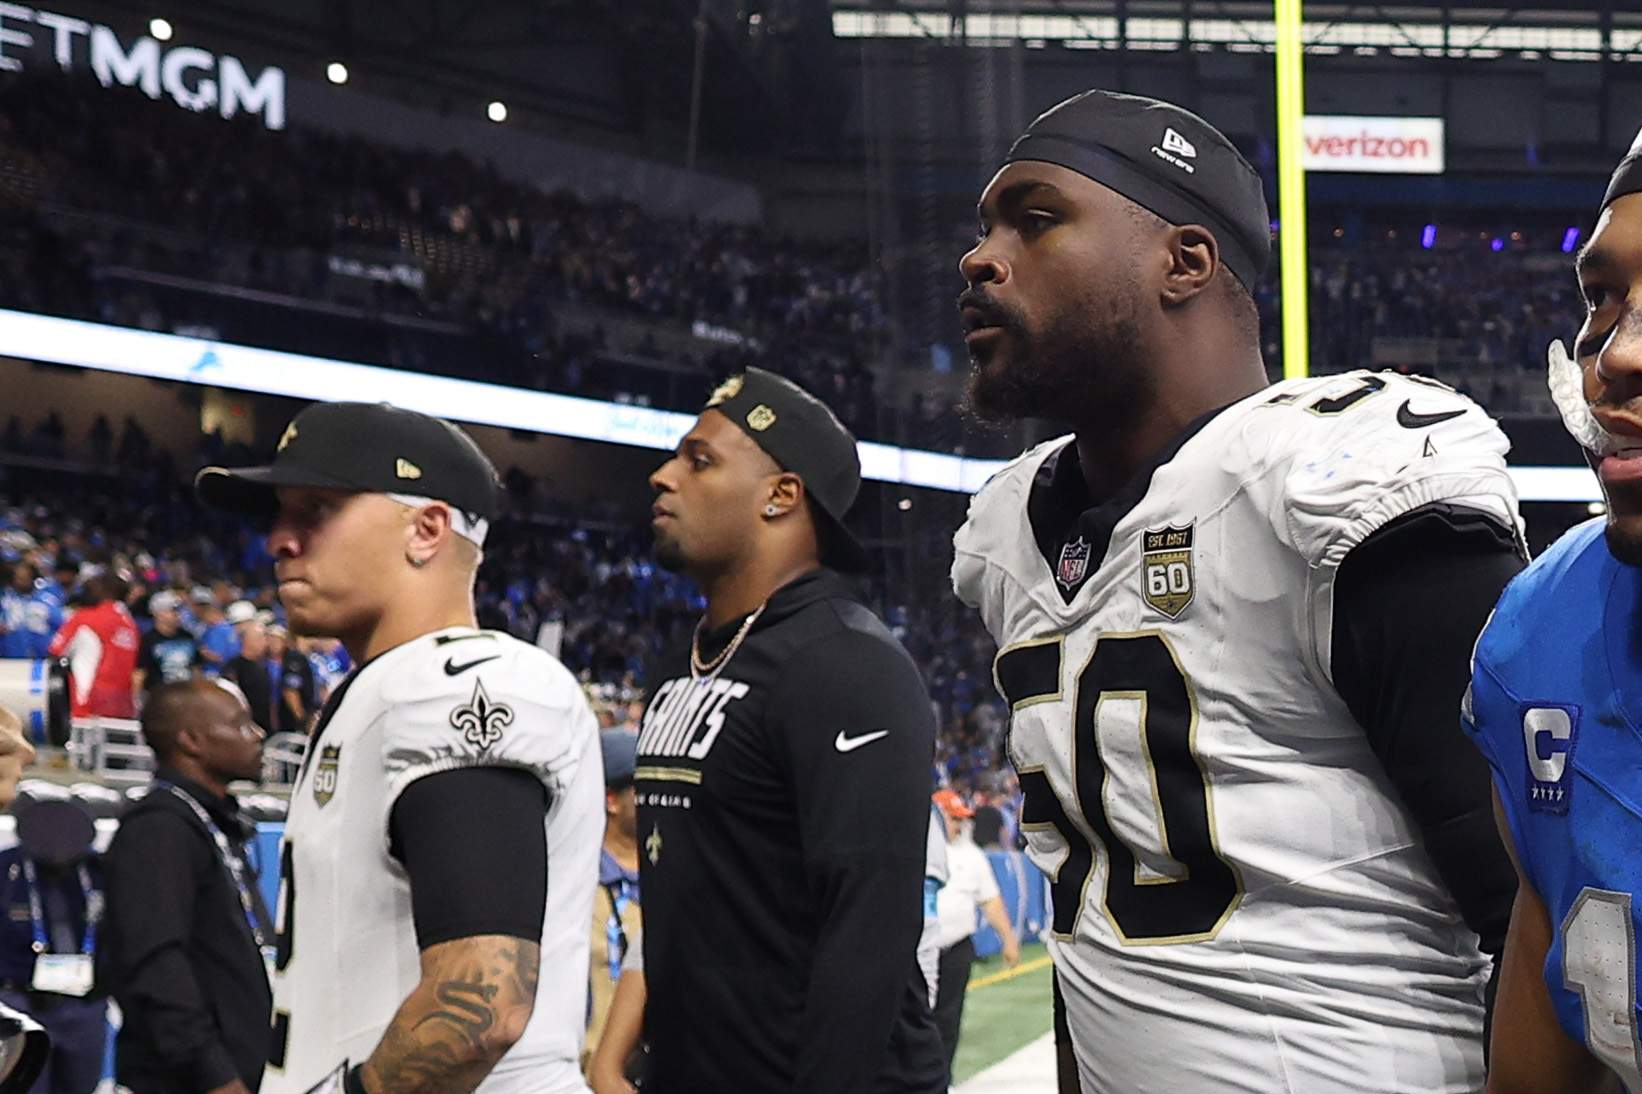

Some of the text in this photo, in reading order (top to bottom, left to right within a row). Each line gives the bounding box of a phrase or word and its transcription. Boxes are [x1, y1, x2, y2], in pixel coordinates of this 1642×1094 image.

[1305, 129, 1430, 158] verizon
[1147, 562, 1190, 596] 60
[1523, 707, 1572, 783] C
[992, 628, 1247, 946] 50
